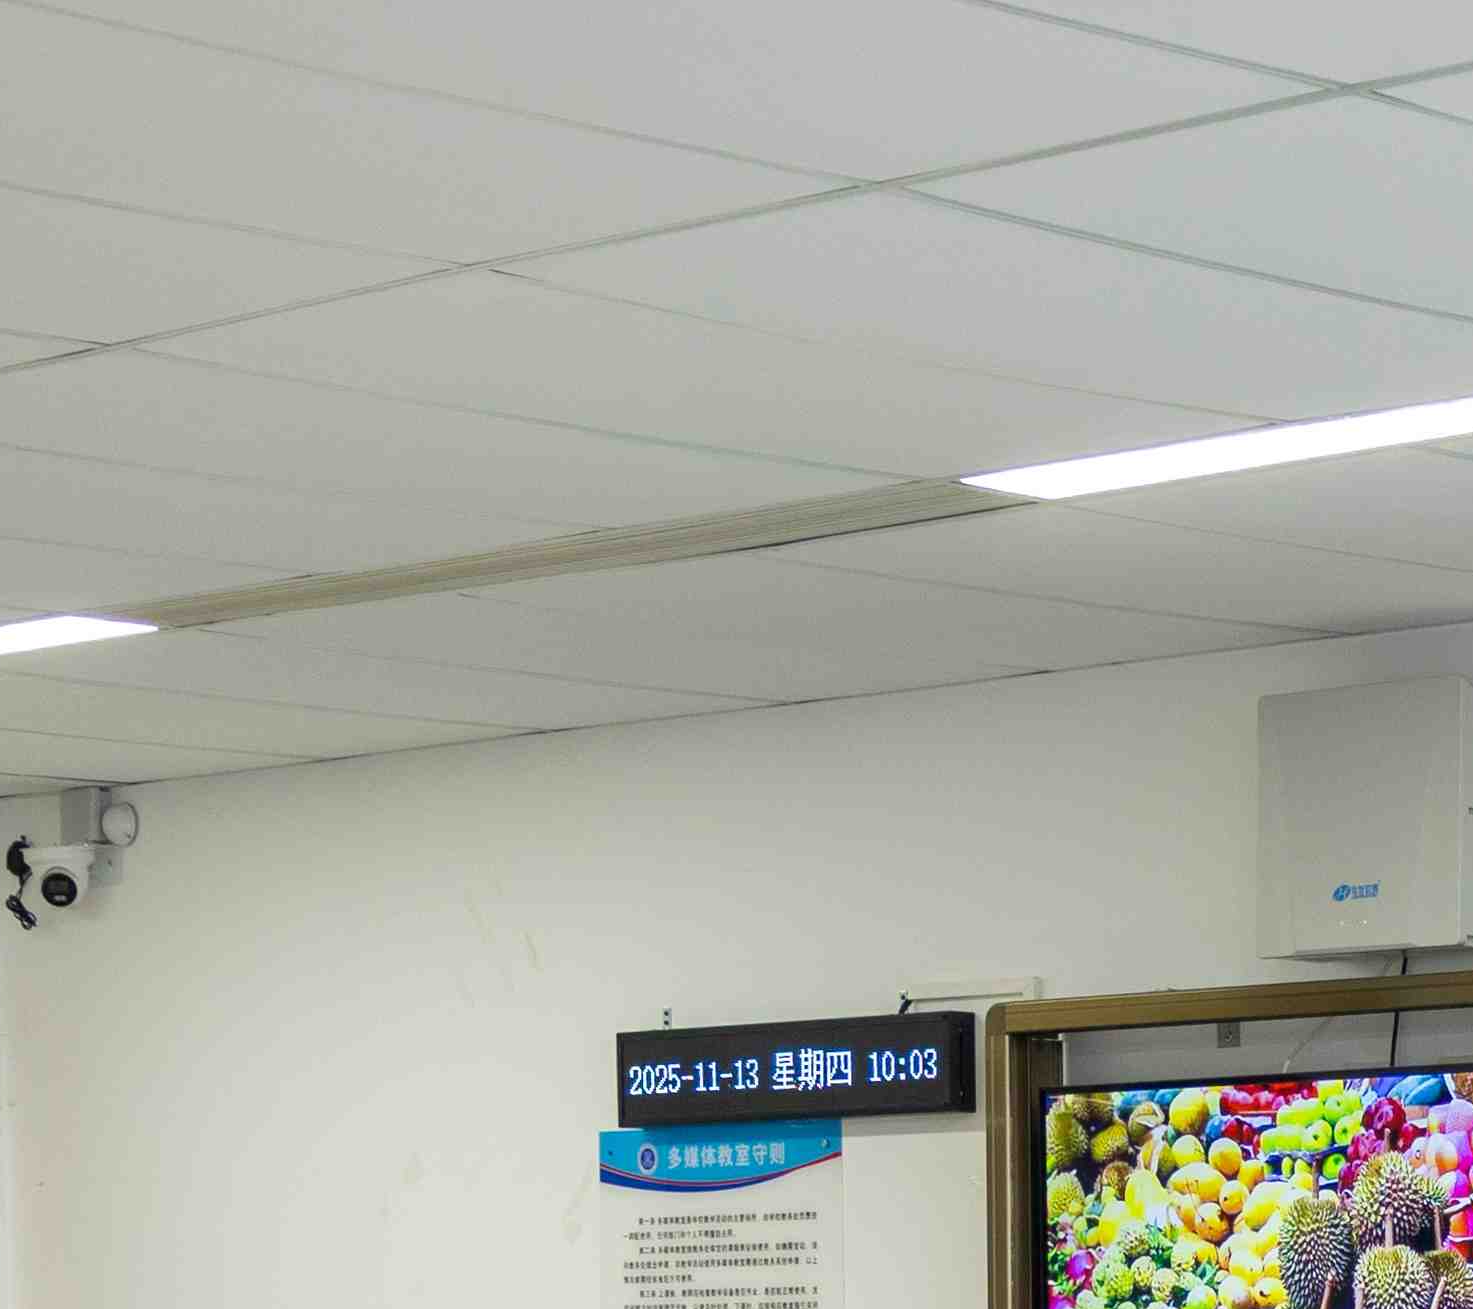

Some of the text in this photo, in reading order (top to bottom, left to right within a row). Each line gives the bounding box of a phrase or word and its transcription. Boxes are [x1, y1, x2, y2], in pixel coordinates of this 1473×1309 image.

[629, 1048, 938, 1095] 2025-11-13 星期四 10:03
[668, 1142, 785, 1170] 多媒体教室守则
